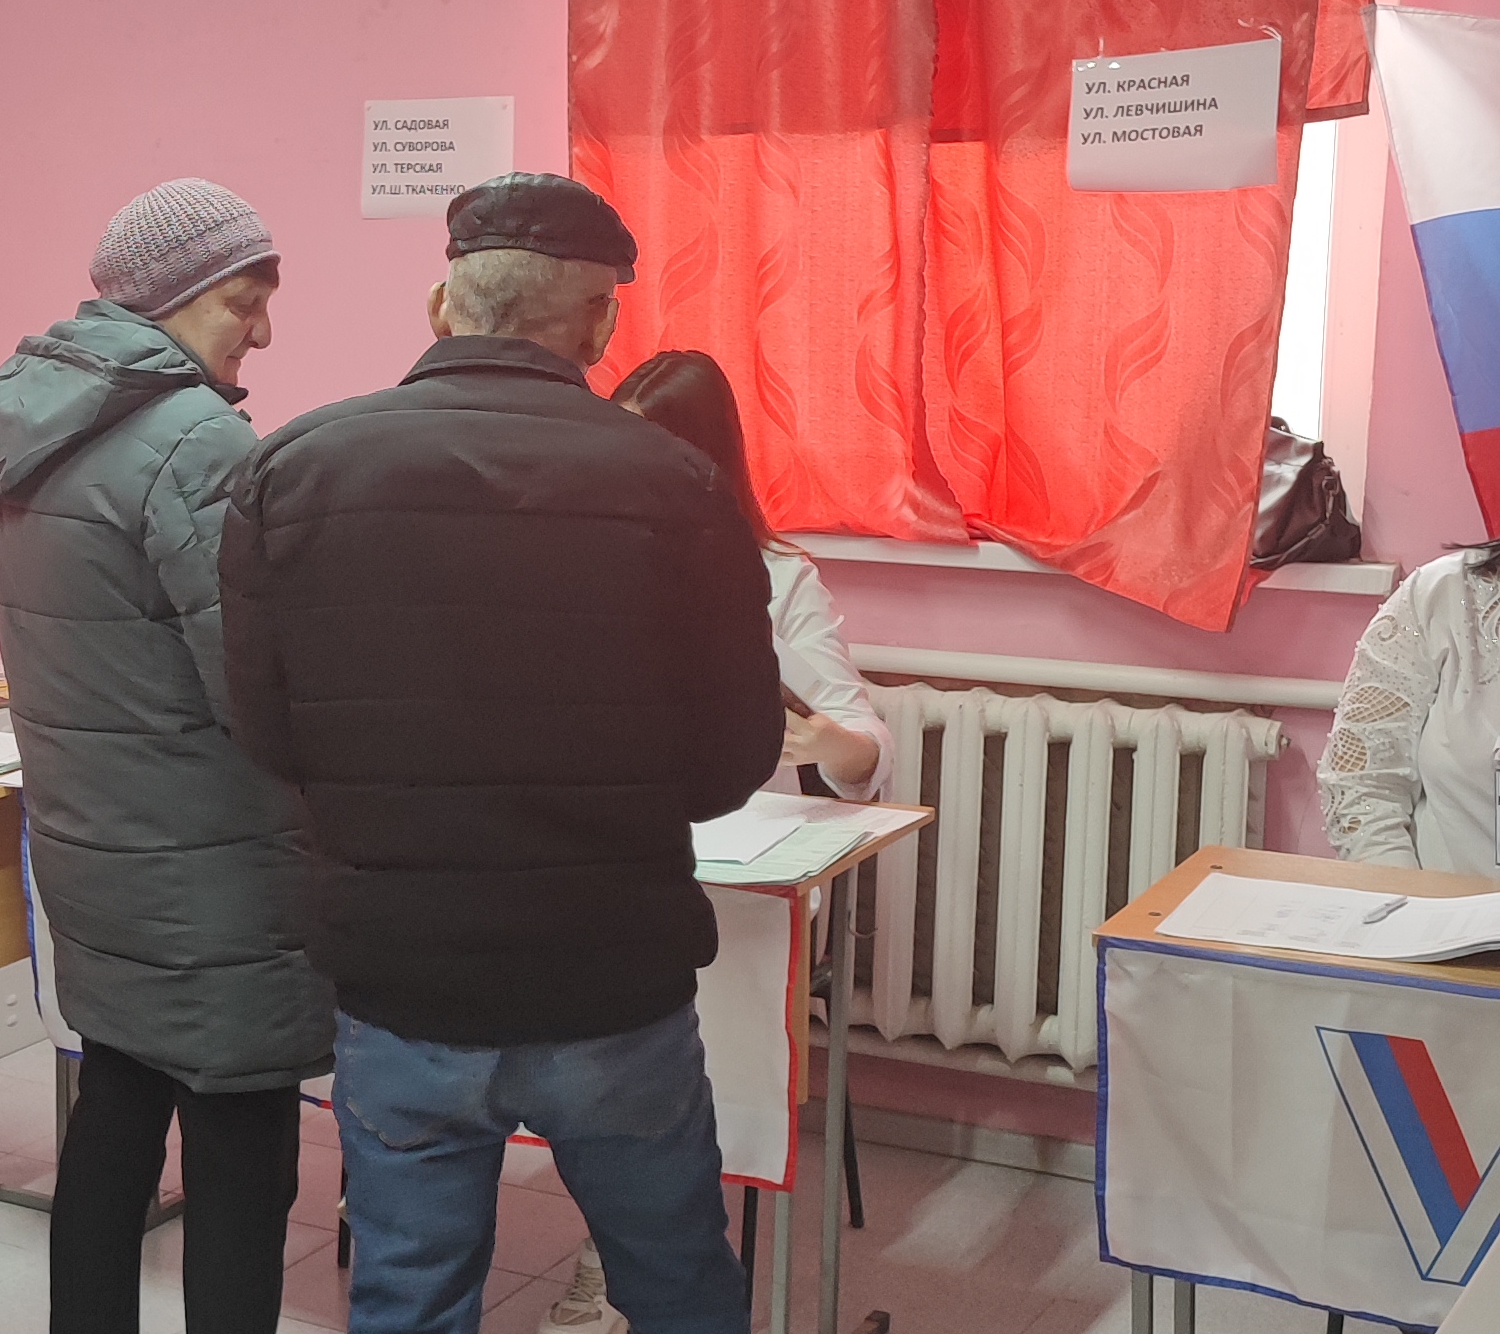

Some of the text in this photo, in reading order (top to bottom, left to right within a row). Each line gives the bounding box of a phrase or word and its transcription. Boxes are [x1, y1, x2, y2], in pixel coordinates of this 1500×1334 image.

[1085, 74, 1190, 95] УЛ. КРАСНАЯ
[1083, 97, 1219, 120] УЛ. ЛЕВЧИШИНА
[373, 119, 449, 132] УЛ. САДОВАЯ
[1081, 124, 1203, 145] УЛ. МОСТОВАЯ
[372, 141, 455, 152] УЛ. СУВОРОВА
[372, 163, 442, 173] УЛ. ТЕРСКАЯ
